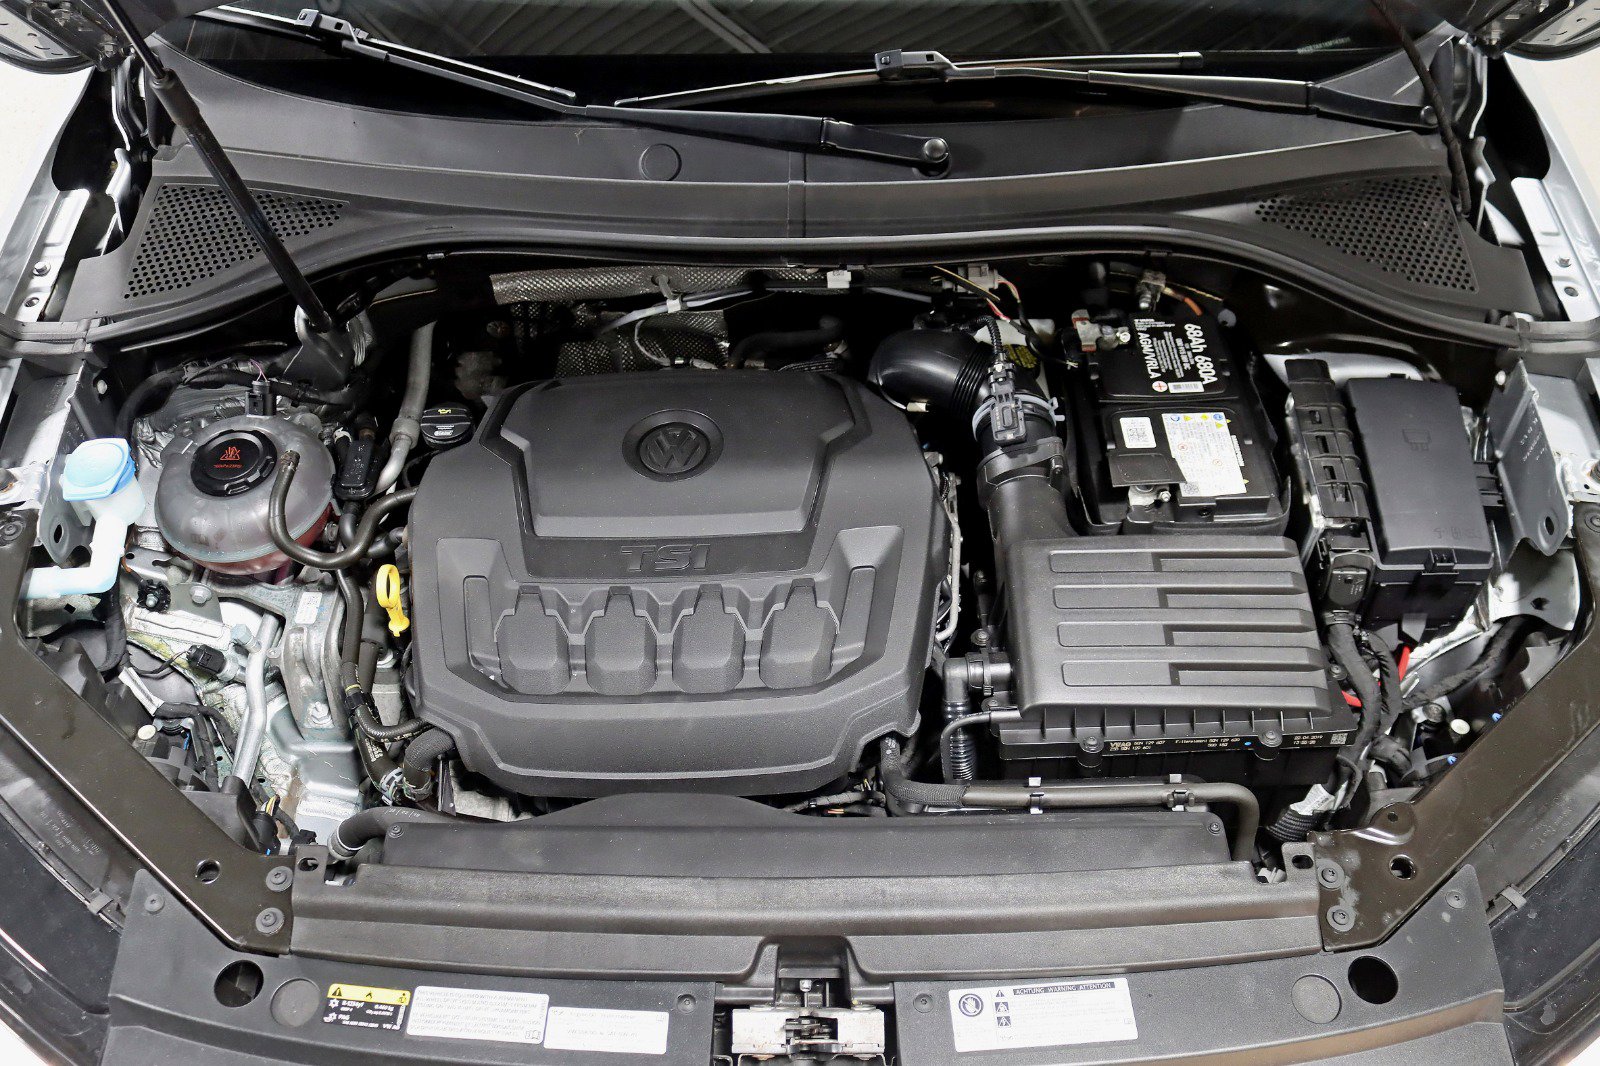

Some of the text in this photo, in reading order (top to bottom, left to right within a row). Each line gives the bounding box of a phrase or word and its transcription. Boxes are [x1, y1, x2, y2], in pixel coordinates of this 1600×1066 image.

[1184, 323, 1207, 353] 68Ah
[1137, 332, 1162, 379] AGM/VRLA
[1194, 355, 1218, 385] 680A
[621, 543, 711, 572] TSI
[1015, 982, 1112, 995] ACHTUNG WARNING ATTENTION
